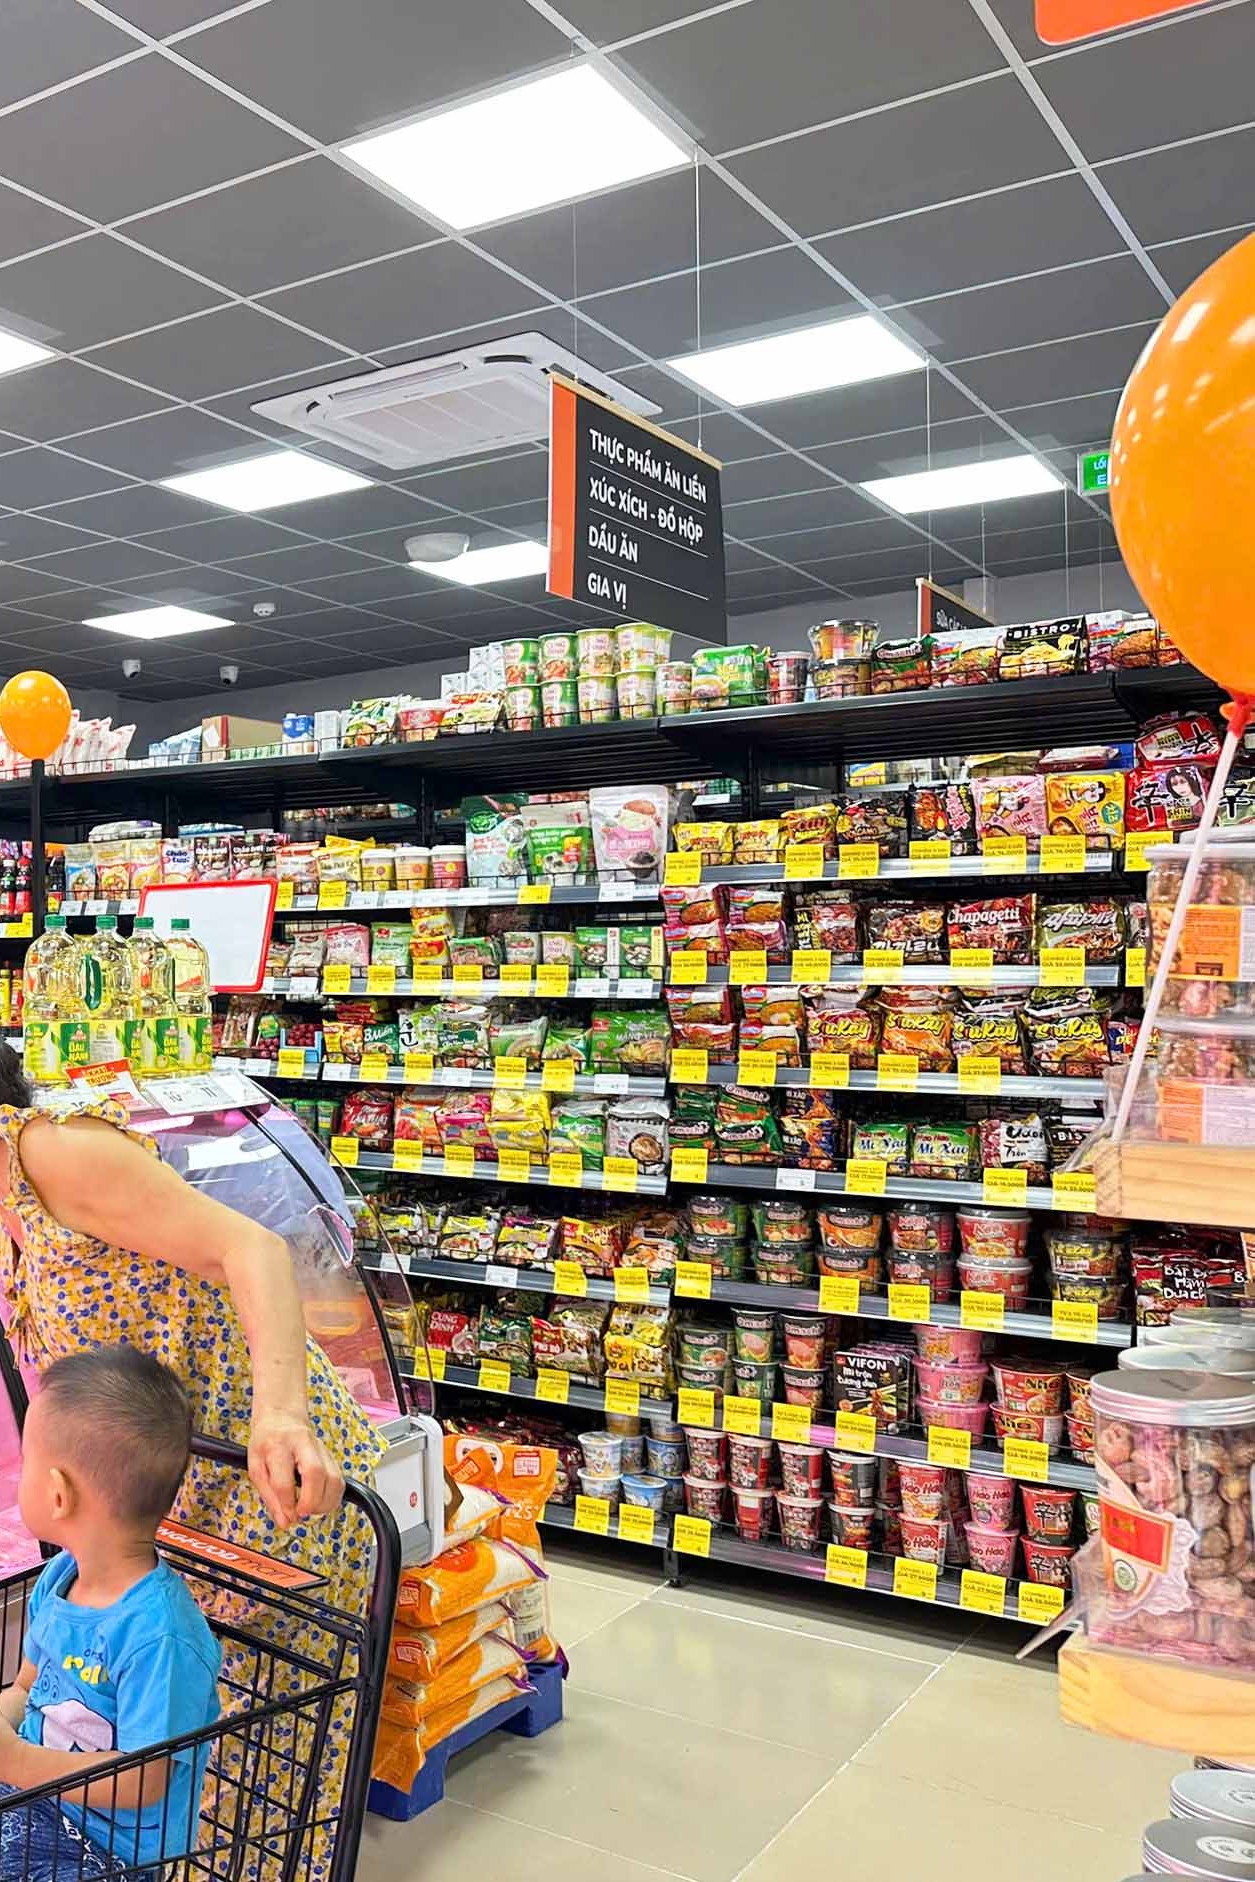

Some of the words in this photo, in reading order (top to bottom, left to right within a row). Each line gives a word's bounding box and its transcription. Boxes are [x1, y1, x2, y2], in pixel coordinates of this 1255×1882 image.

[589, 428, 624, 465] THỰC
[627, 449, 660, 483] PHẨM
[664, 461, 681, 491] ĂN
[589, 476, 616, 508] XÚC
[619, 488, 647, 521] XÍCH
[658, 505, 677, 532] ĐỒ
[678, 515, 703, 545] HỘP
[588, 522, 616, 555] DẦU
[619, 533, 638, 563] ĂN
[587, 573, 611, 598] GIA
[613, 581, 627, 609] VỊ
[1012, 623, 1071, 640] BISTRO
[1131, 782, 1171, 825] 辛
[946, 907, 1020, 928] Chapagetti
[847, 1357, 888, 1371] VIFON
